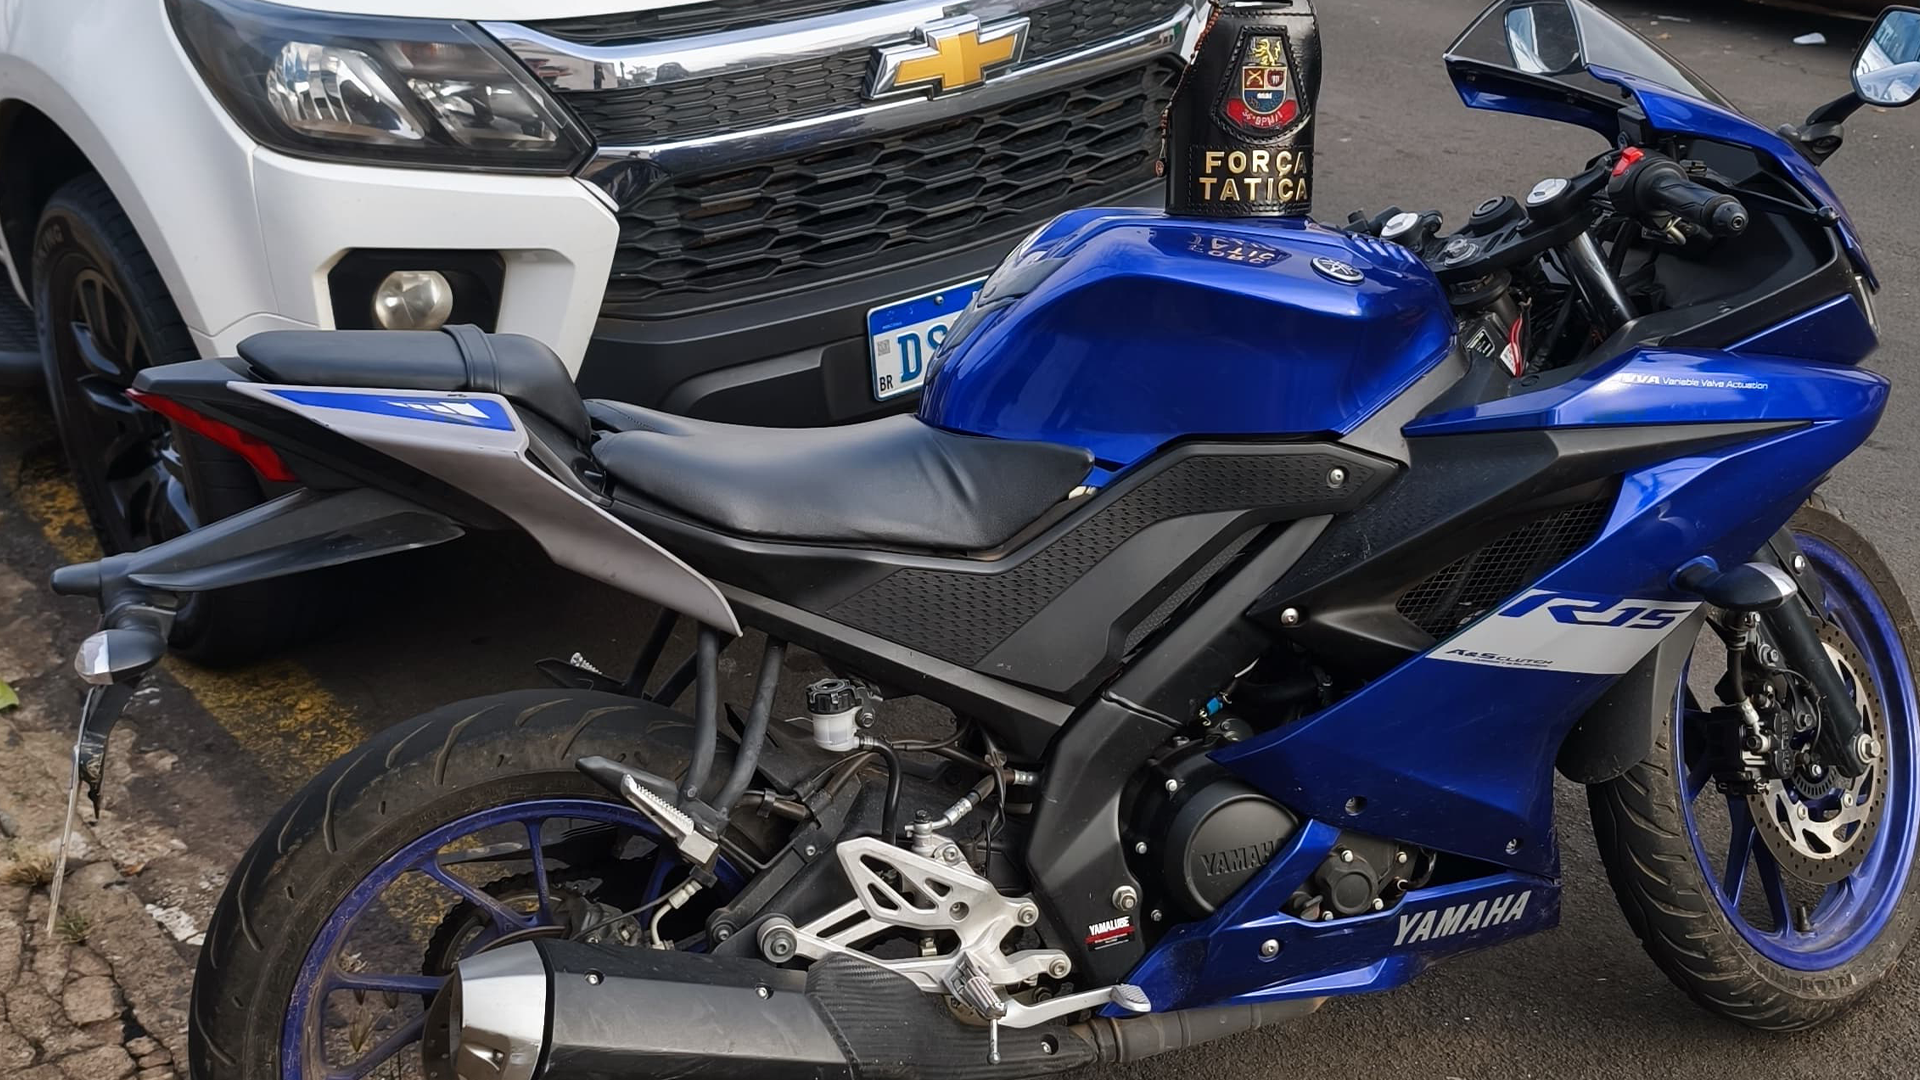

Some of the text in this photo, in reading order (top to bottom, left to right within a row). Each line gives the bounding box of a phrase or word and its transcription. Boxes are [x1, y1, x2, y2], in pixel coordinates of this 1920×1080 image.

[1205, 150, 1307, 176] FORÇA
[1199, 177, 1308, 201] TATICA
[879, 375, 893, 391] BR
[1662, 378, 1699, 387] Variable
[1701, 380, 1724, 388] Valve
[1726, 381, 1768, 390] Actuation
[1200, 839, 1281, 876] YAMAH
[1088, 916, 1130, 936] YAMALUBE
[1393, 890, 1532, 946] YAMAHA
